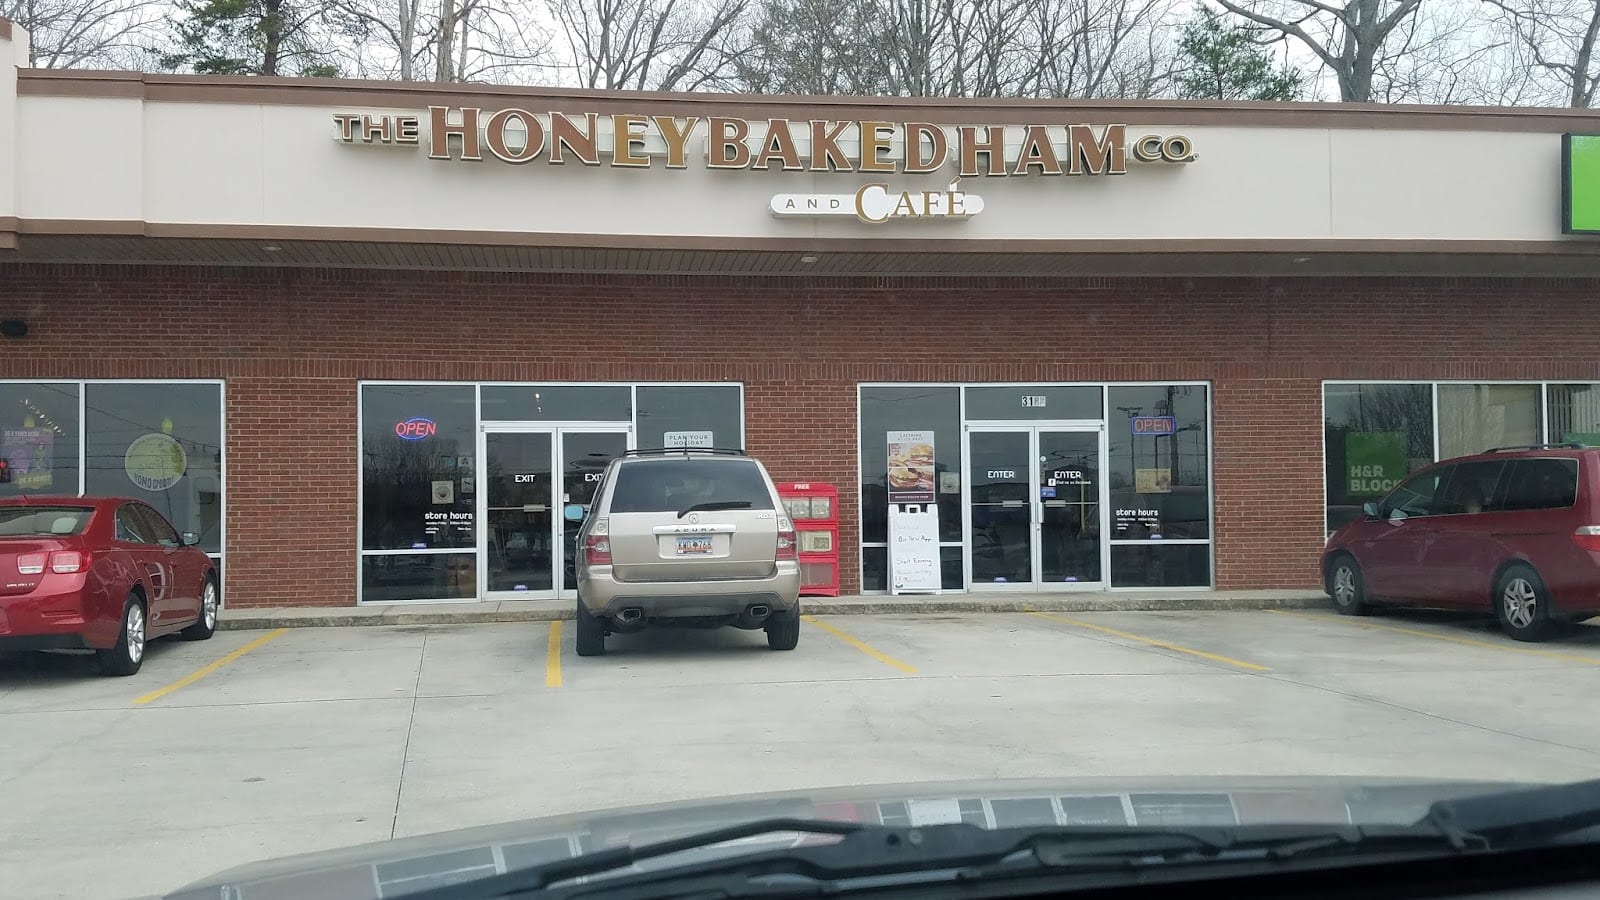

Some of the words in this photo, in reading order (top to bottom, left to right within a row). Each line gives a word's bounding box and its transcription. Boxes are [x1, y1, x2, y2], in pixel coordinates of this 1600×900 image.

[333, 113, 419, 143] THE
[956, 124, 1129, 177] HAM
[785, 198, 841, 209] AND
[395, 422, 437, 436] OPEN
[1134, 418, 1173, 432] OPEN
[987, 470, 1015, 479] ENTER
[1054, 470, 1082, 479] ENTER
[1351, 465, 1384, 478] H&R
[514, 474, 536, 483] EXIT
[424, 511, 448, 520] store
[449, 511, 473, 520] hours
[1115, 508, 1136, 516] store
[1137, 508, 1159, 516] hours
